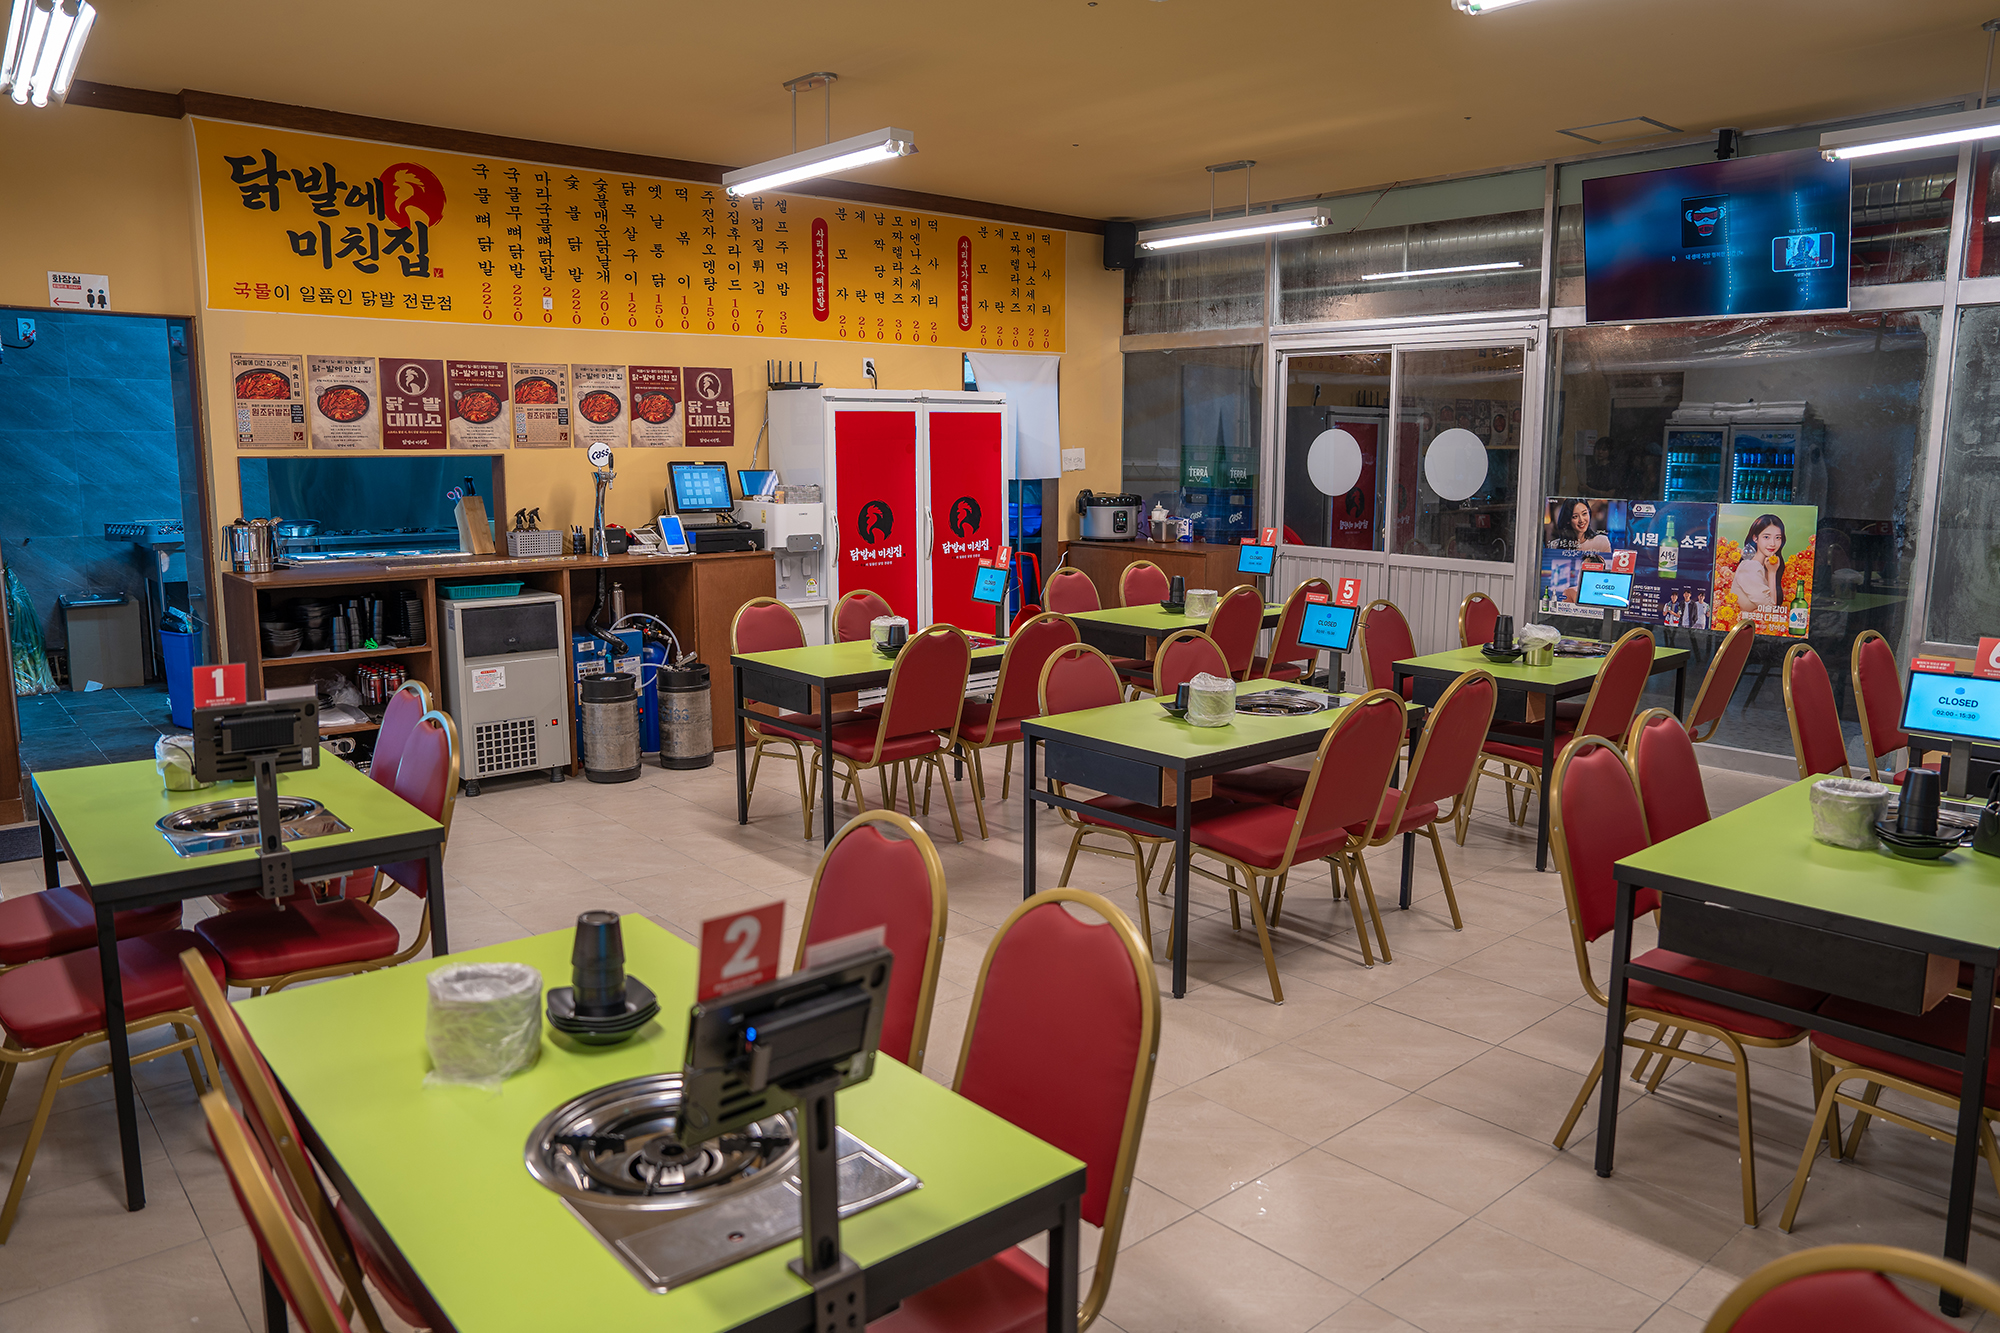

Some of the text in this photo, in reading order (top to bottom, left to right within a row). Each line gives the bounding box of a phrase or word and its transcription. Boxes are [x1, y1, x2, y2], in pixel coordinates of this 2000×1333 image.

[224, 148, 386, 221] 닭발에
[286, 220, 431, 278] 미친집
[472, 163, 495, 320] 국물뼈닭발 22.0
[503, 167, 526, 322] 국물무뼈닭발 22.0
[534, 170, 555, 281] 마라국물뼈닭발
[563, 174, 584, 325] 숯불닭발 22.0
[592, 177, 612, 326] 숯불매운닭날개 20.0
[621, 180, 638, 328] 닭목살구이 12.0
[648, 184, 666, 329] 옛날통닭 15.0
[675, 186, 691, 330] 떡볶이 10.0
[52, 274, 81, 284] 화장실
[701, 190, 718, 331] 주전자오뎅탕 15.0
[751, 195, 765, 333] 닭껍질튀김 7.0
[775, 199, 790, 334] 셀프주먹밥 3.5
[835, 207, 849, 338] 분모자 2.0
[854, 210, 868, 339] 계란 2.0
[891, 216, 904, 341] 모짜렐라치즈 3.0
[909, 218, 921, 307] 비엔나소세지
[928, 220, 939, 343] 떡사리 2.0
[977, 226, 989, 312] 분모자
[994, 228, 1005, 313] 계란
[1026, 232, 1037, 316] 비엔나소세지
[1041, 233, 1051, 316] 떡사리
[233, 281, 452, 311] 국물이 일품인 닭발 전문점
[731, 299, 740, 332] 10.0
[876, 318, 885, 340] 2.0
[251, 408, 291, 417] 원조닭발집
[386, 413, 443, 427] 대피소
[688, 415, 731, 427] 대피소
[1189, 466, 1209, 478] TERRA
[1230, 467, 1247, 479] TERRA
[849, 547, 876, 561] 닭발에
[942, 540, 966, 554] 닭발에
[1000, 548, 1007, 563] 4
[1266, 529, 1274, 542] 7
[1618, 552, 1630, 567] 8
[1632, 532, 1707, 549] 시원 소주
[1343, 580, 1355, 599] 5
[1757, 604, 1788, 614] 이슬같이
[211, 667, 224, 697] 1
[1936, 709, 1954, 717] 02:00
[1959, 712, 1976, 720] 15:30
[1938, 696, 1979, 708] CLOSED
[721, 914, 762, 980] 2
